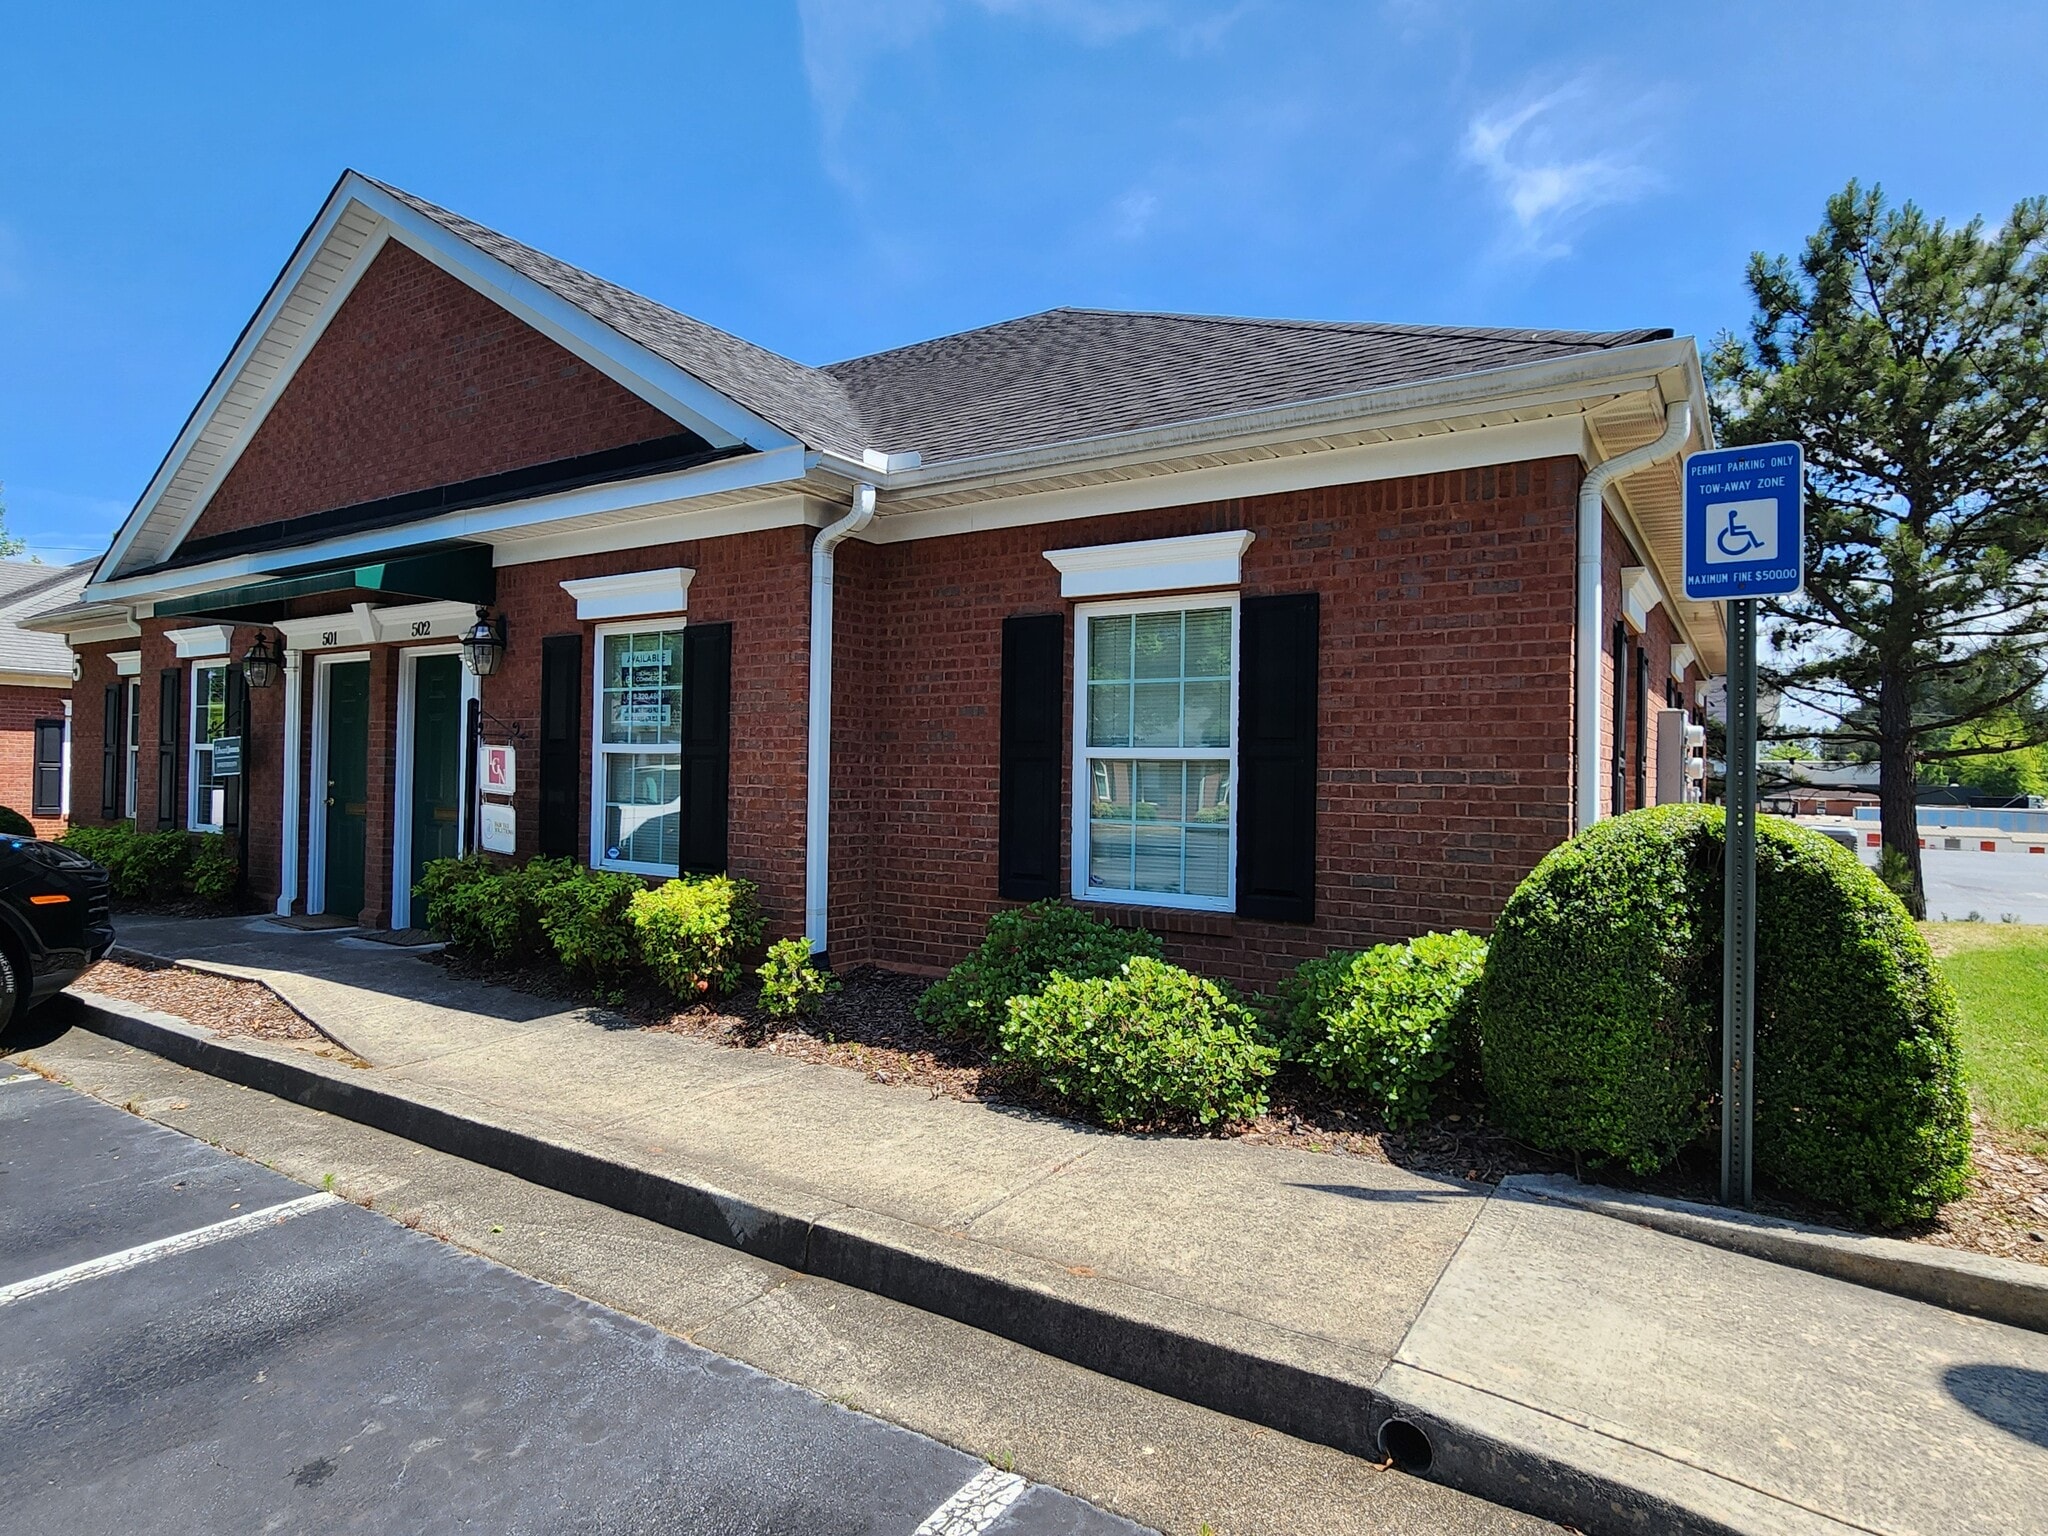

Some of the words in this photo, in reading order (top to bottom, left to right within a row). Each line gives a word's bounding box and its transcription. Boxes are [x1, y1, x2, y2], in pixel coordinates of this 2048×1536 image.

[1691, 463, 1722, 477] PERMIT
[1728, 458, 1765, 473] PARKING
[1771, 455, 1794, 467] ONLY
[1699, 480, 1752, 495] TOW-AWAY
[1757, 476, 1786, 489] ZONE
[1688, 572, 1728, 586] MAXIMUM
[1734, 571, 1753, 583] FINE
[411, 620, 431, 637] 502
[322, 631, 338, 646] 501
